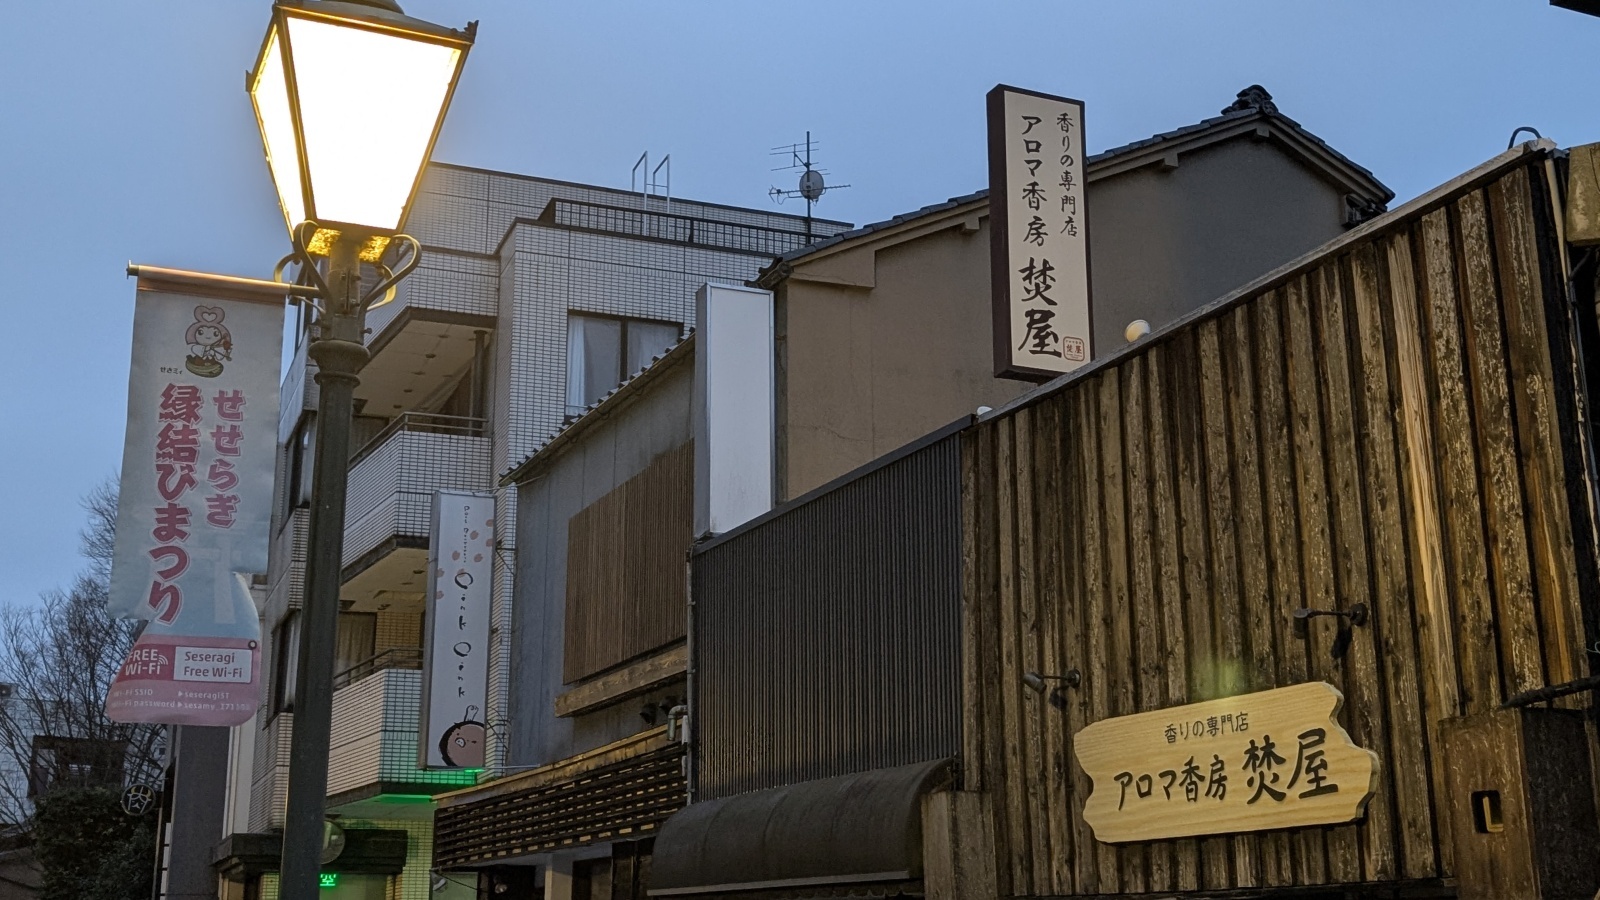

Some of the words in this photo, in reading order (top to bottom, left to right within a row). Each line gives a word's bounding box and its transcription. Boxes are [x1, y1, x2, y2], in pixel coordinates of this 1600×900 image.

[1021, 115, 1049, 247] アロマ香房
[1056, 112, 1078, 237] 香りの専門店
[1018, 257, 1062, 358] 焚屋
[205, 388, 246, 529] せせらぎ
[148, 382, 204, 626] 縁結びまつり
[125, 662, 161, 676] Wi-Fi
[128, 649, 159, 663] FREE
[184, 666, 209, 677] Free
[212, 667, 242, 678] Wi-Fi
[185, 651, 235, 665] Seseragi
[134, 688, 153, 696] SSID
[134, 700, 175, 708] password
[1164, 711, 1249, 744] 香りの専門店
[1114, 754, 1228, 811] アロマ香房
[1242, 727, 1339, 804] 焚屋
